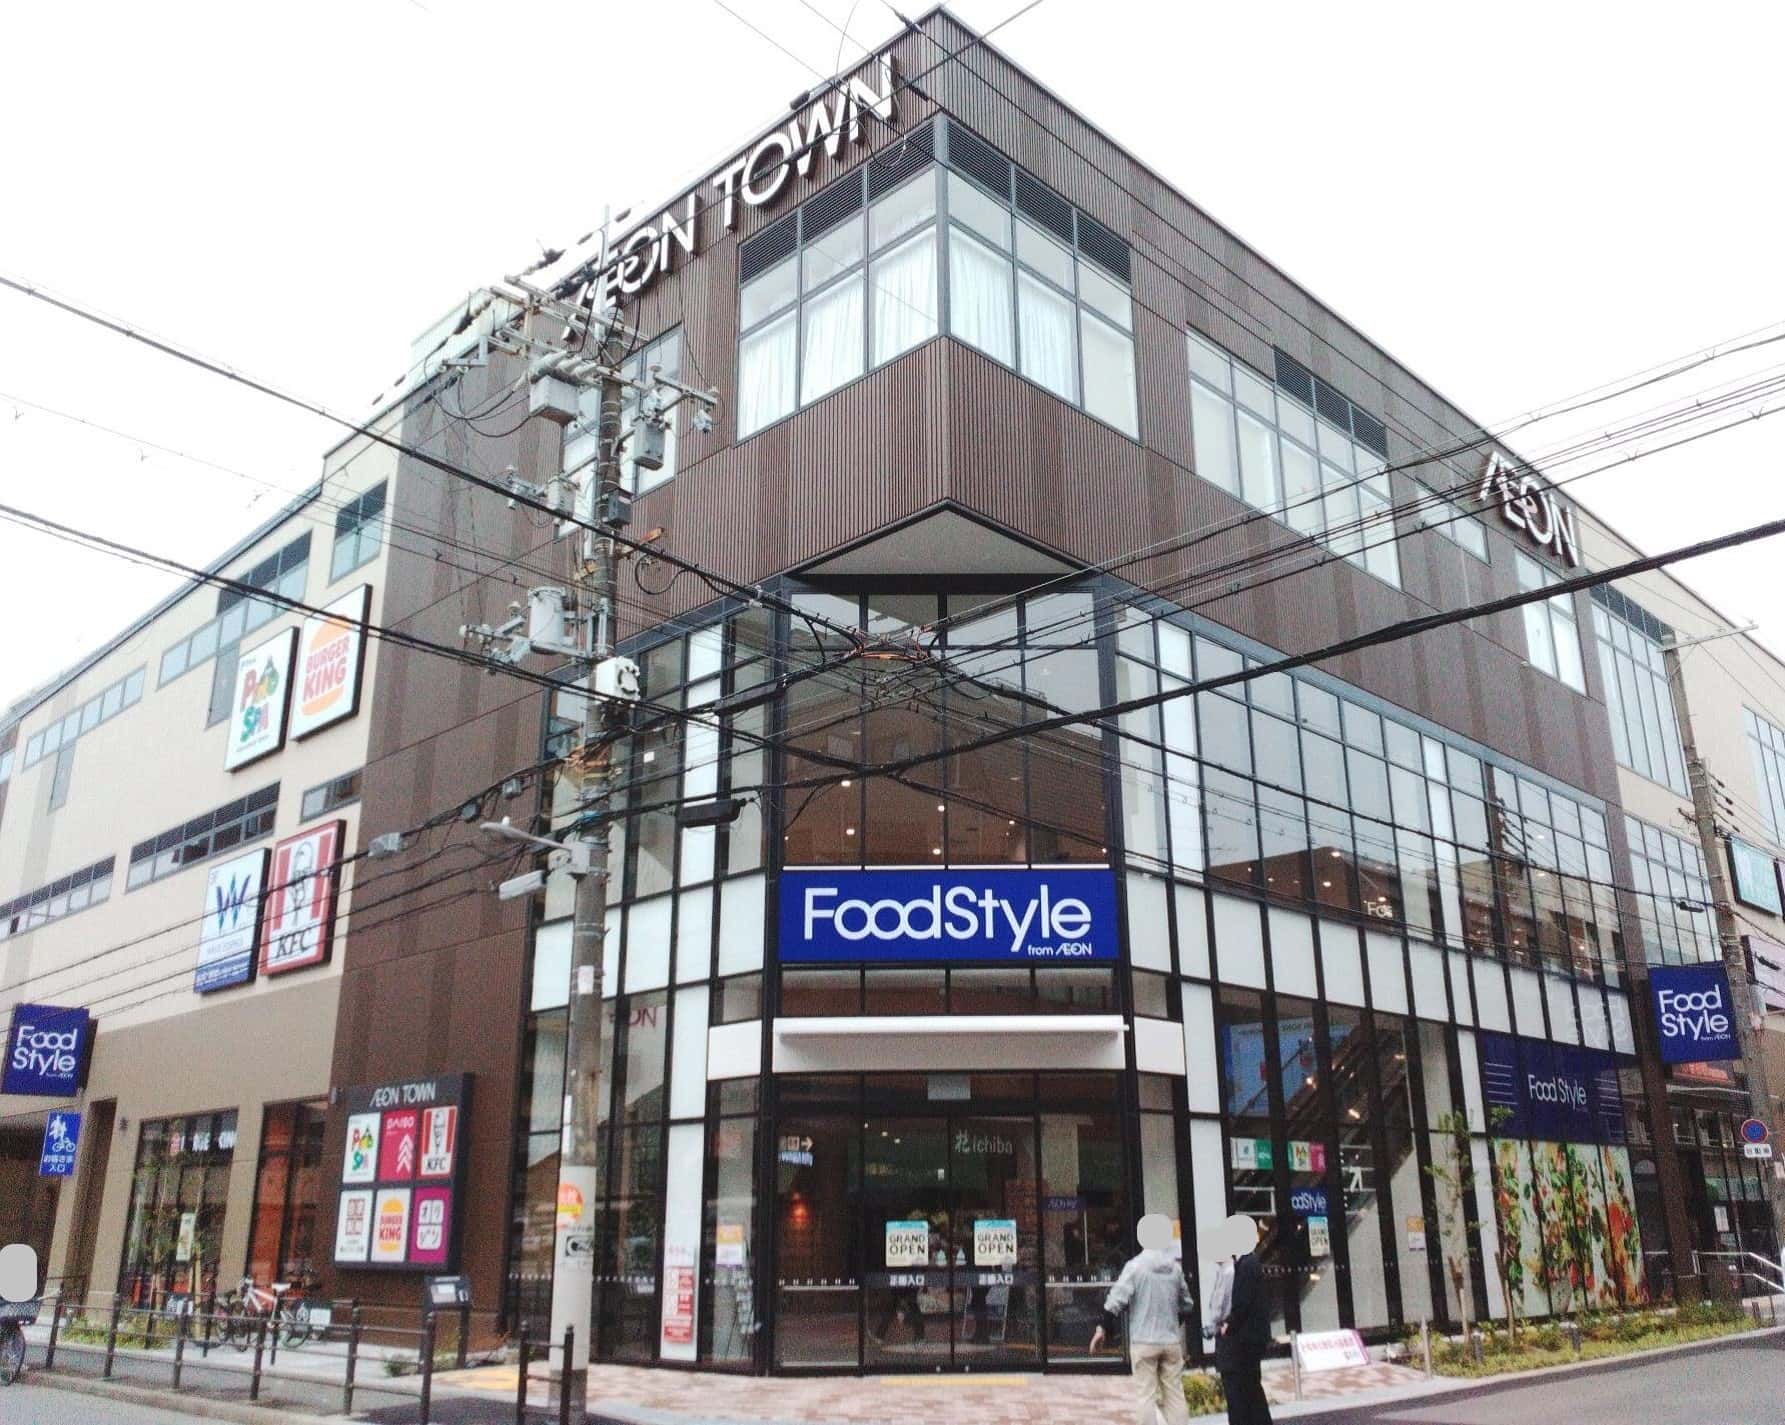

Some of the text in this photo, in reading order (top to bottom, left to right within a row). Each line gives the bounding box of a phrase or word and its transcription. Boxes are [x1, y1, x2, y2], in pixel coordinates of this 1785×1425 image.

[712, 52, 894, 228] TOWN
[305, 636, 350, 673] BURGER
[303, 657, 348, 702] KING
[276, 930, 312, 959] KFC
[1027, 943, 1054, 956] from
[1658, 984, 1723, 1014] Food
[1661, 1009, 1729, 1041] Style
[16, 1025, 78, 1050] Food
[12, 1046, 76, 1076] Style
[402, 1082, 436, 1104] TOWN
[386, 1116, 415, 1129] DAISO
[49, 1163, 66, 1172] 入口
[425, 1156, 447, 1171] KFC
[379, 1225, 402, 1240] KING
[889, 1233, 925, 1243] GRAND
[977, 1232, 1014, 1242] GRAND
[889, 1244, 925, 1255] OPEN
[978, 1243, 1014, 1255] OPEN
